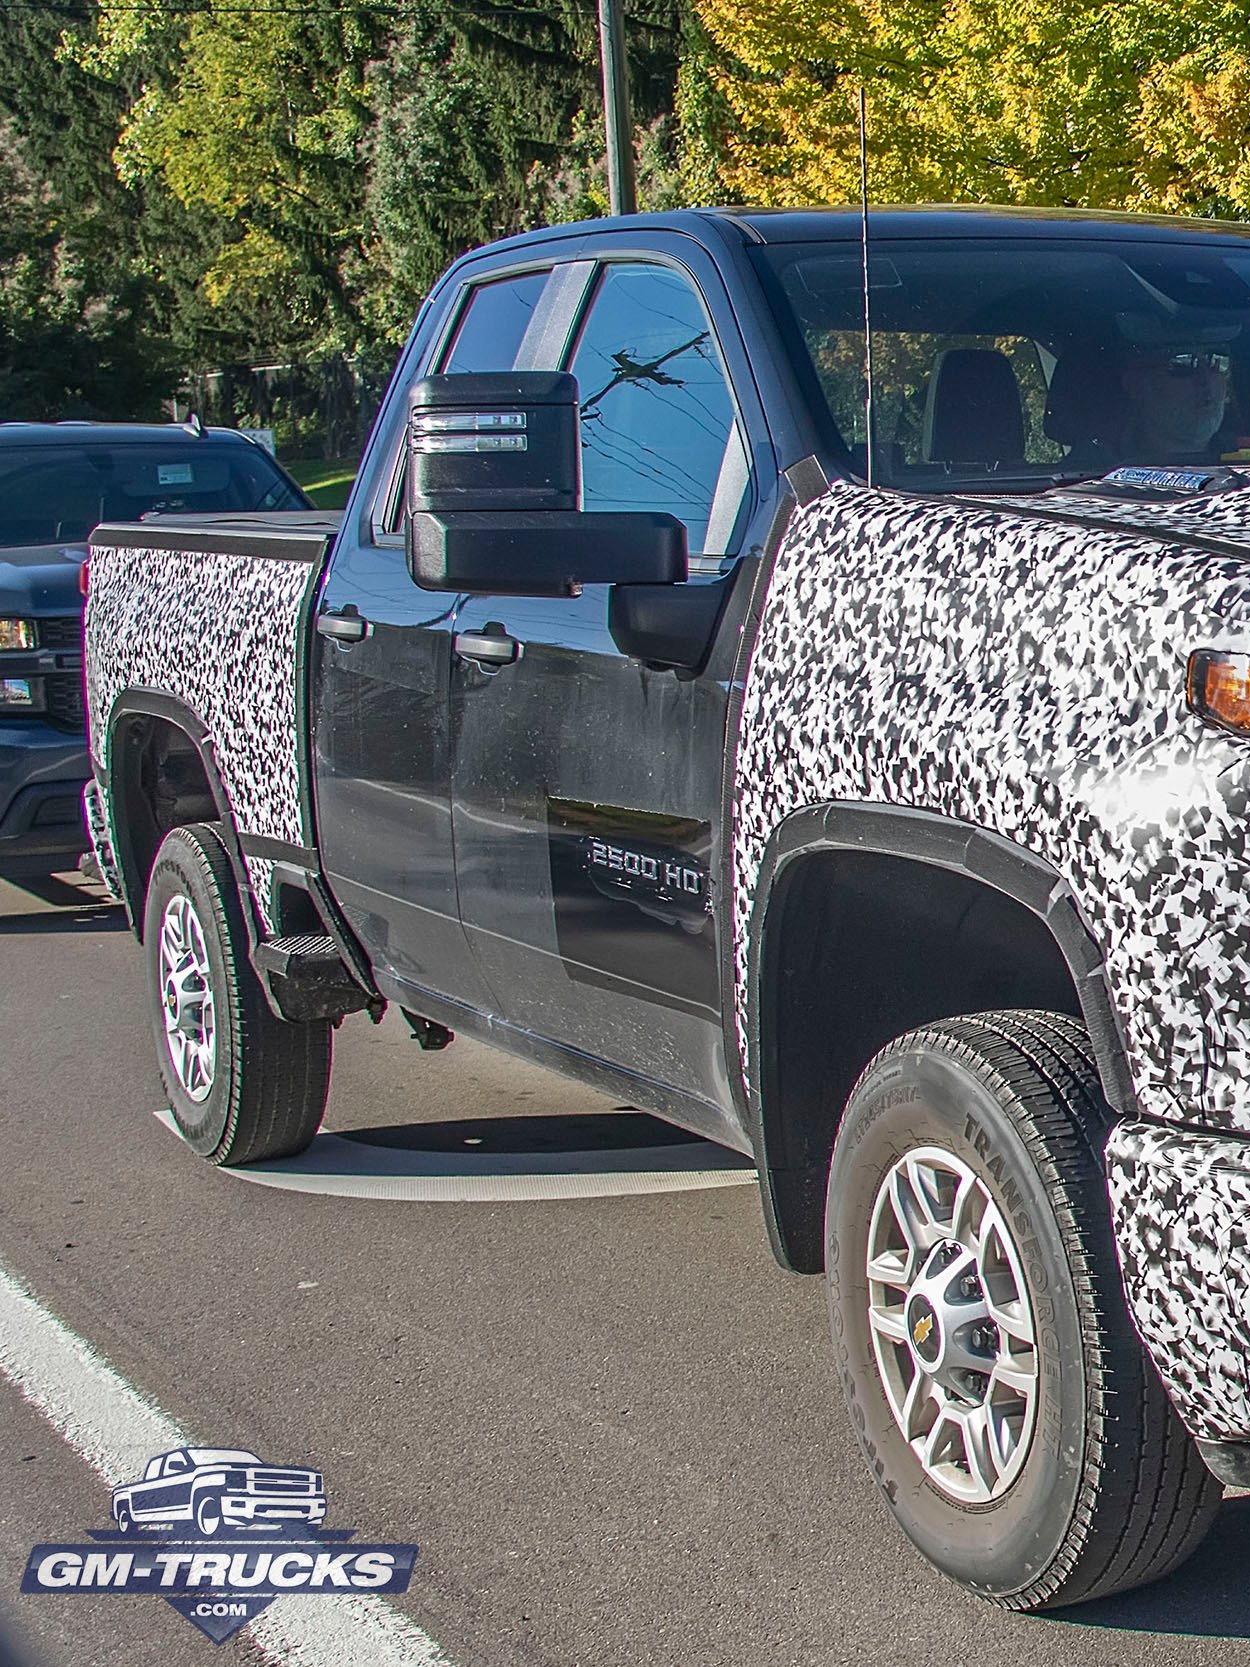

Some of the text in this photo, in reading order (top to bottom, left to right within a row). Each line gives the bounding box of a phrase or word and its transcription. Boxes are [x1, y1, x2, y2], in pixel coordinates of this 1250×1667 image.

[592, 842, 700, 894] 2500 HD
[964, 1112, 1062, 1381] TRANSFORCE
